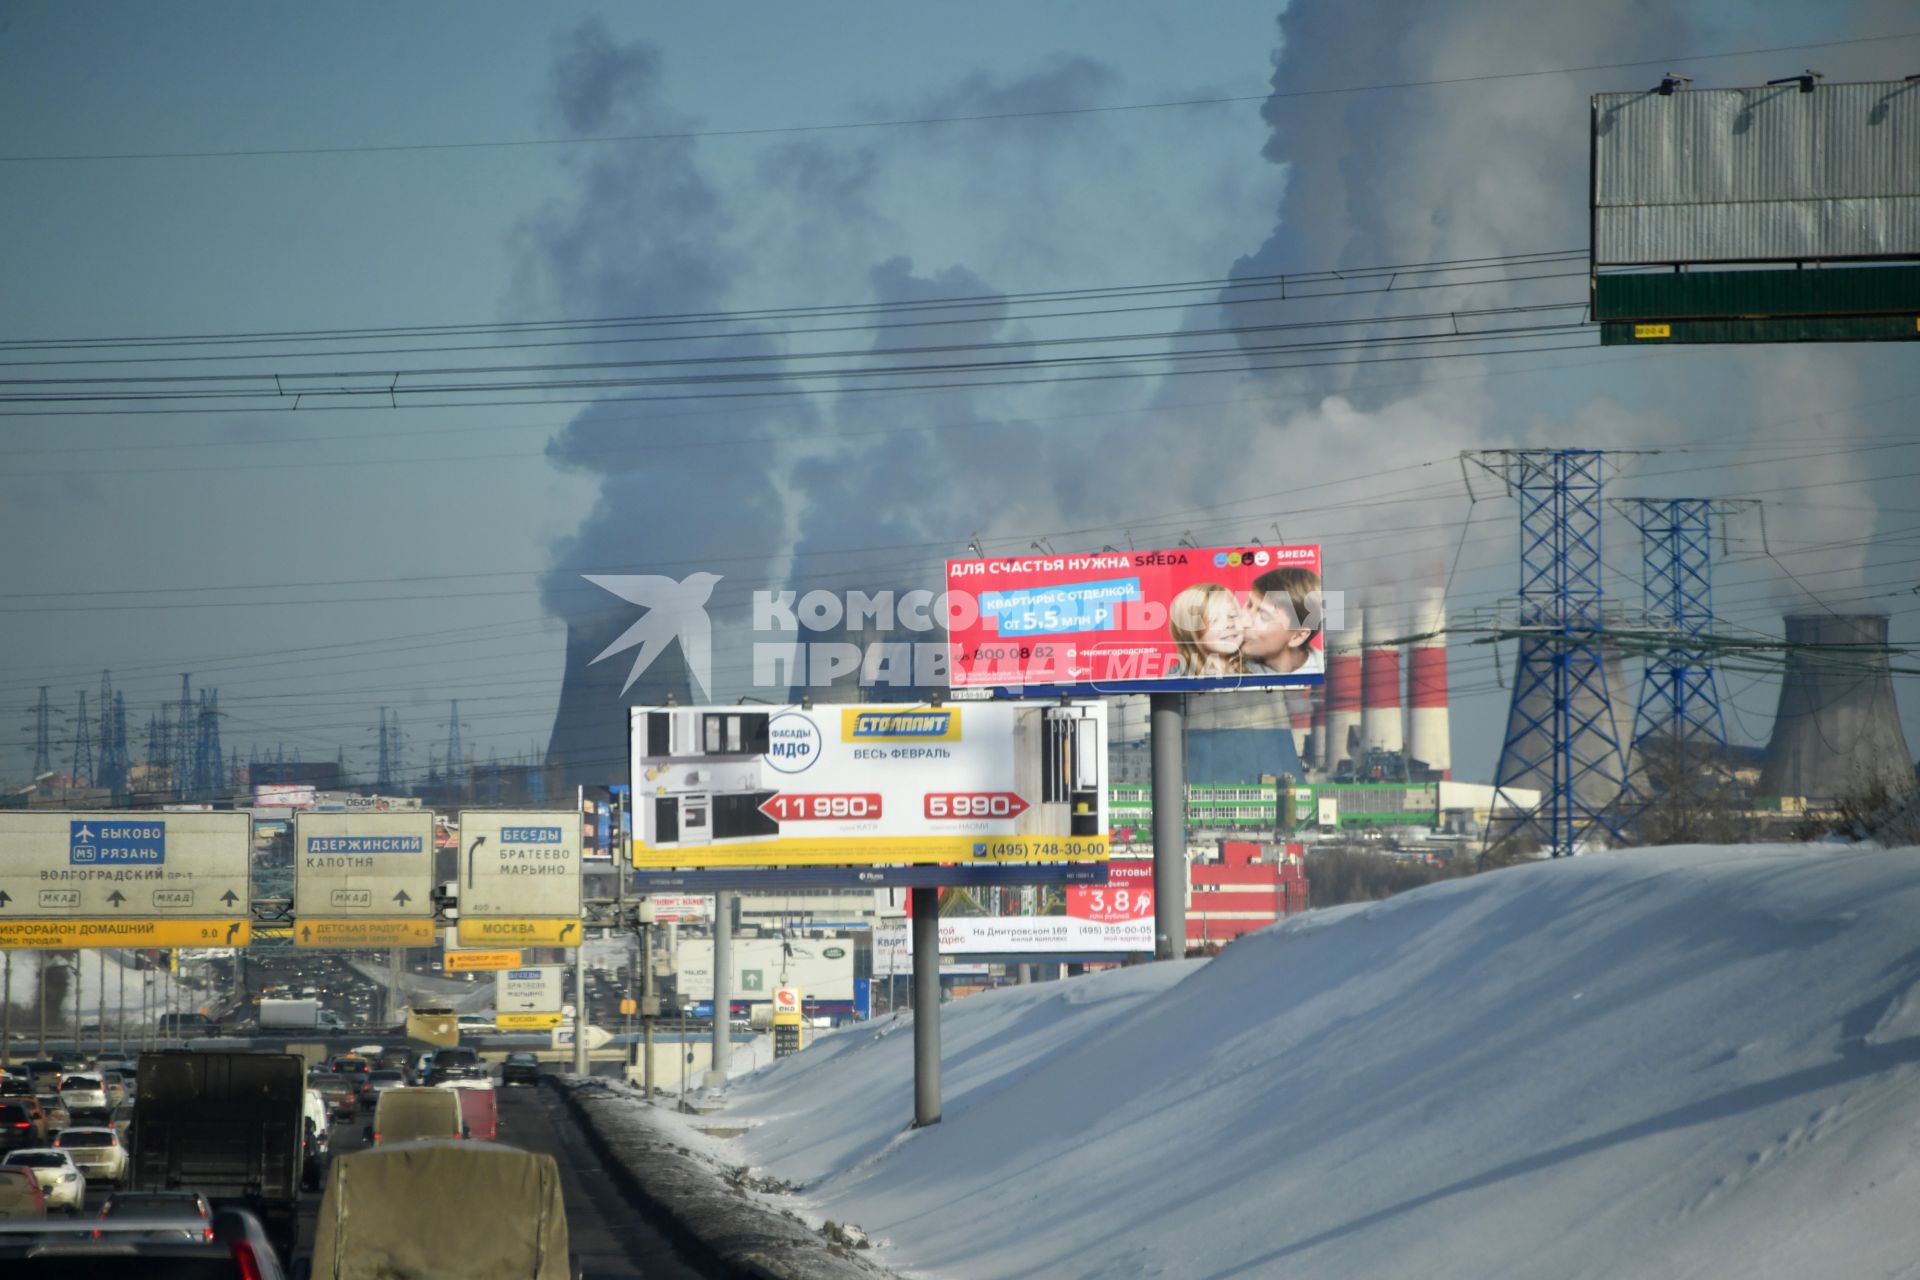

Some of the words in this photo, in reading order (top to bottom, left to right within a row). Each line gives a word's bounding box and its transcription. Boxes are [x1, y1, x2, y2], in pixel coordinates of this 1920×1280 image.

[1277, 549, 1315, 559] SREDA
[950, 563, 985, 577] ДЛЯ
[989, 558, 1064, 574] СЧАСТЬЯ
[1068, 556, 1130, 570] НУЖНА
[1135, 554, 1189, 567] SREDA
[986, 593, 1055, 610] КВАРТИРЫ
[1057, 593, 1065, 603] С
[1067, 583, 1136, 601] ОТДЕЛКОЙ
[1023, 611, 1058, 631] 5,5
[973, 648, 1005, 660] 800
[1009, 647, 1030, 660] 08
[1034, 646, 1054, 658] 82
[771, 729, 811, 739] ФАСАДЫ
[772, 743, 811, 758] МДФ
[854, 749, 887, 759] ВЕСЬ
[890, 748, 951, 760] ФЕВРАЛЬ
[346, 798, 374, 807] ОБОИ
[101, 829, 161, 839] БЫКОВО
[503, 830, 559, 841] БЕСЕДЫ
[310, 837, 420, 851] ДЗЕРЖИНСКИЙ
[101, 848, 158, 859] РЯЗАНЬ
[500, 850, 569, 860] БРАТЕЕВО
[992, 843, 1028, 858] (495)
[1033, 843, 1105, 856] 748-30-00
[306, 857, 374, 868] КАПОТНЯ
[41, 867, 164, 882] ВОЛГОГРАДСКИЙ
[501, 865, 565, 875] МАРЬИНО
[1110, 867, 1152, 877] готовы!
[43, 893, 77, 903] МКАД
[157, 893, 191, 903] МКАД
[335, 893, 368, 903] МКАД
[1090, 890, 1130, 914] 3,8
[79, 923, 155, 936] ДОМАШНИЙ
[201, 929, 218, 938] 9.0
[317, 924, 367, 933] ДЕТСКАЯ
[369, 924, 410, 933] РАДУГА
[483, 923, 535, 934] МОСКВА
[987, 927, 1050, 937] Дмитровском
[1079, 926, 1102, 935] (495)
[1104, 926, 1152, 935] 255-00-05
